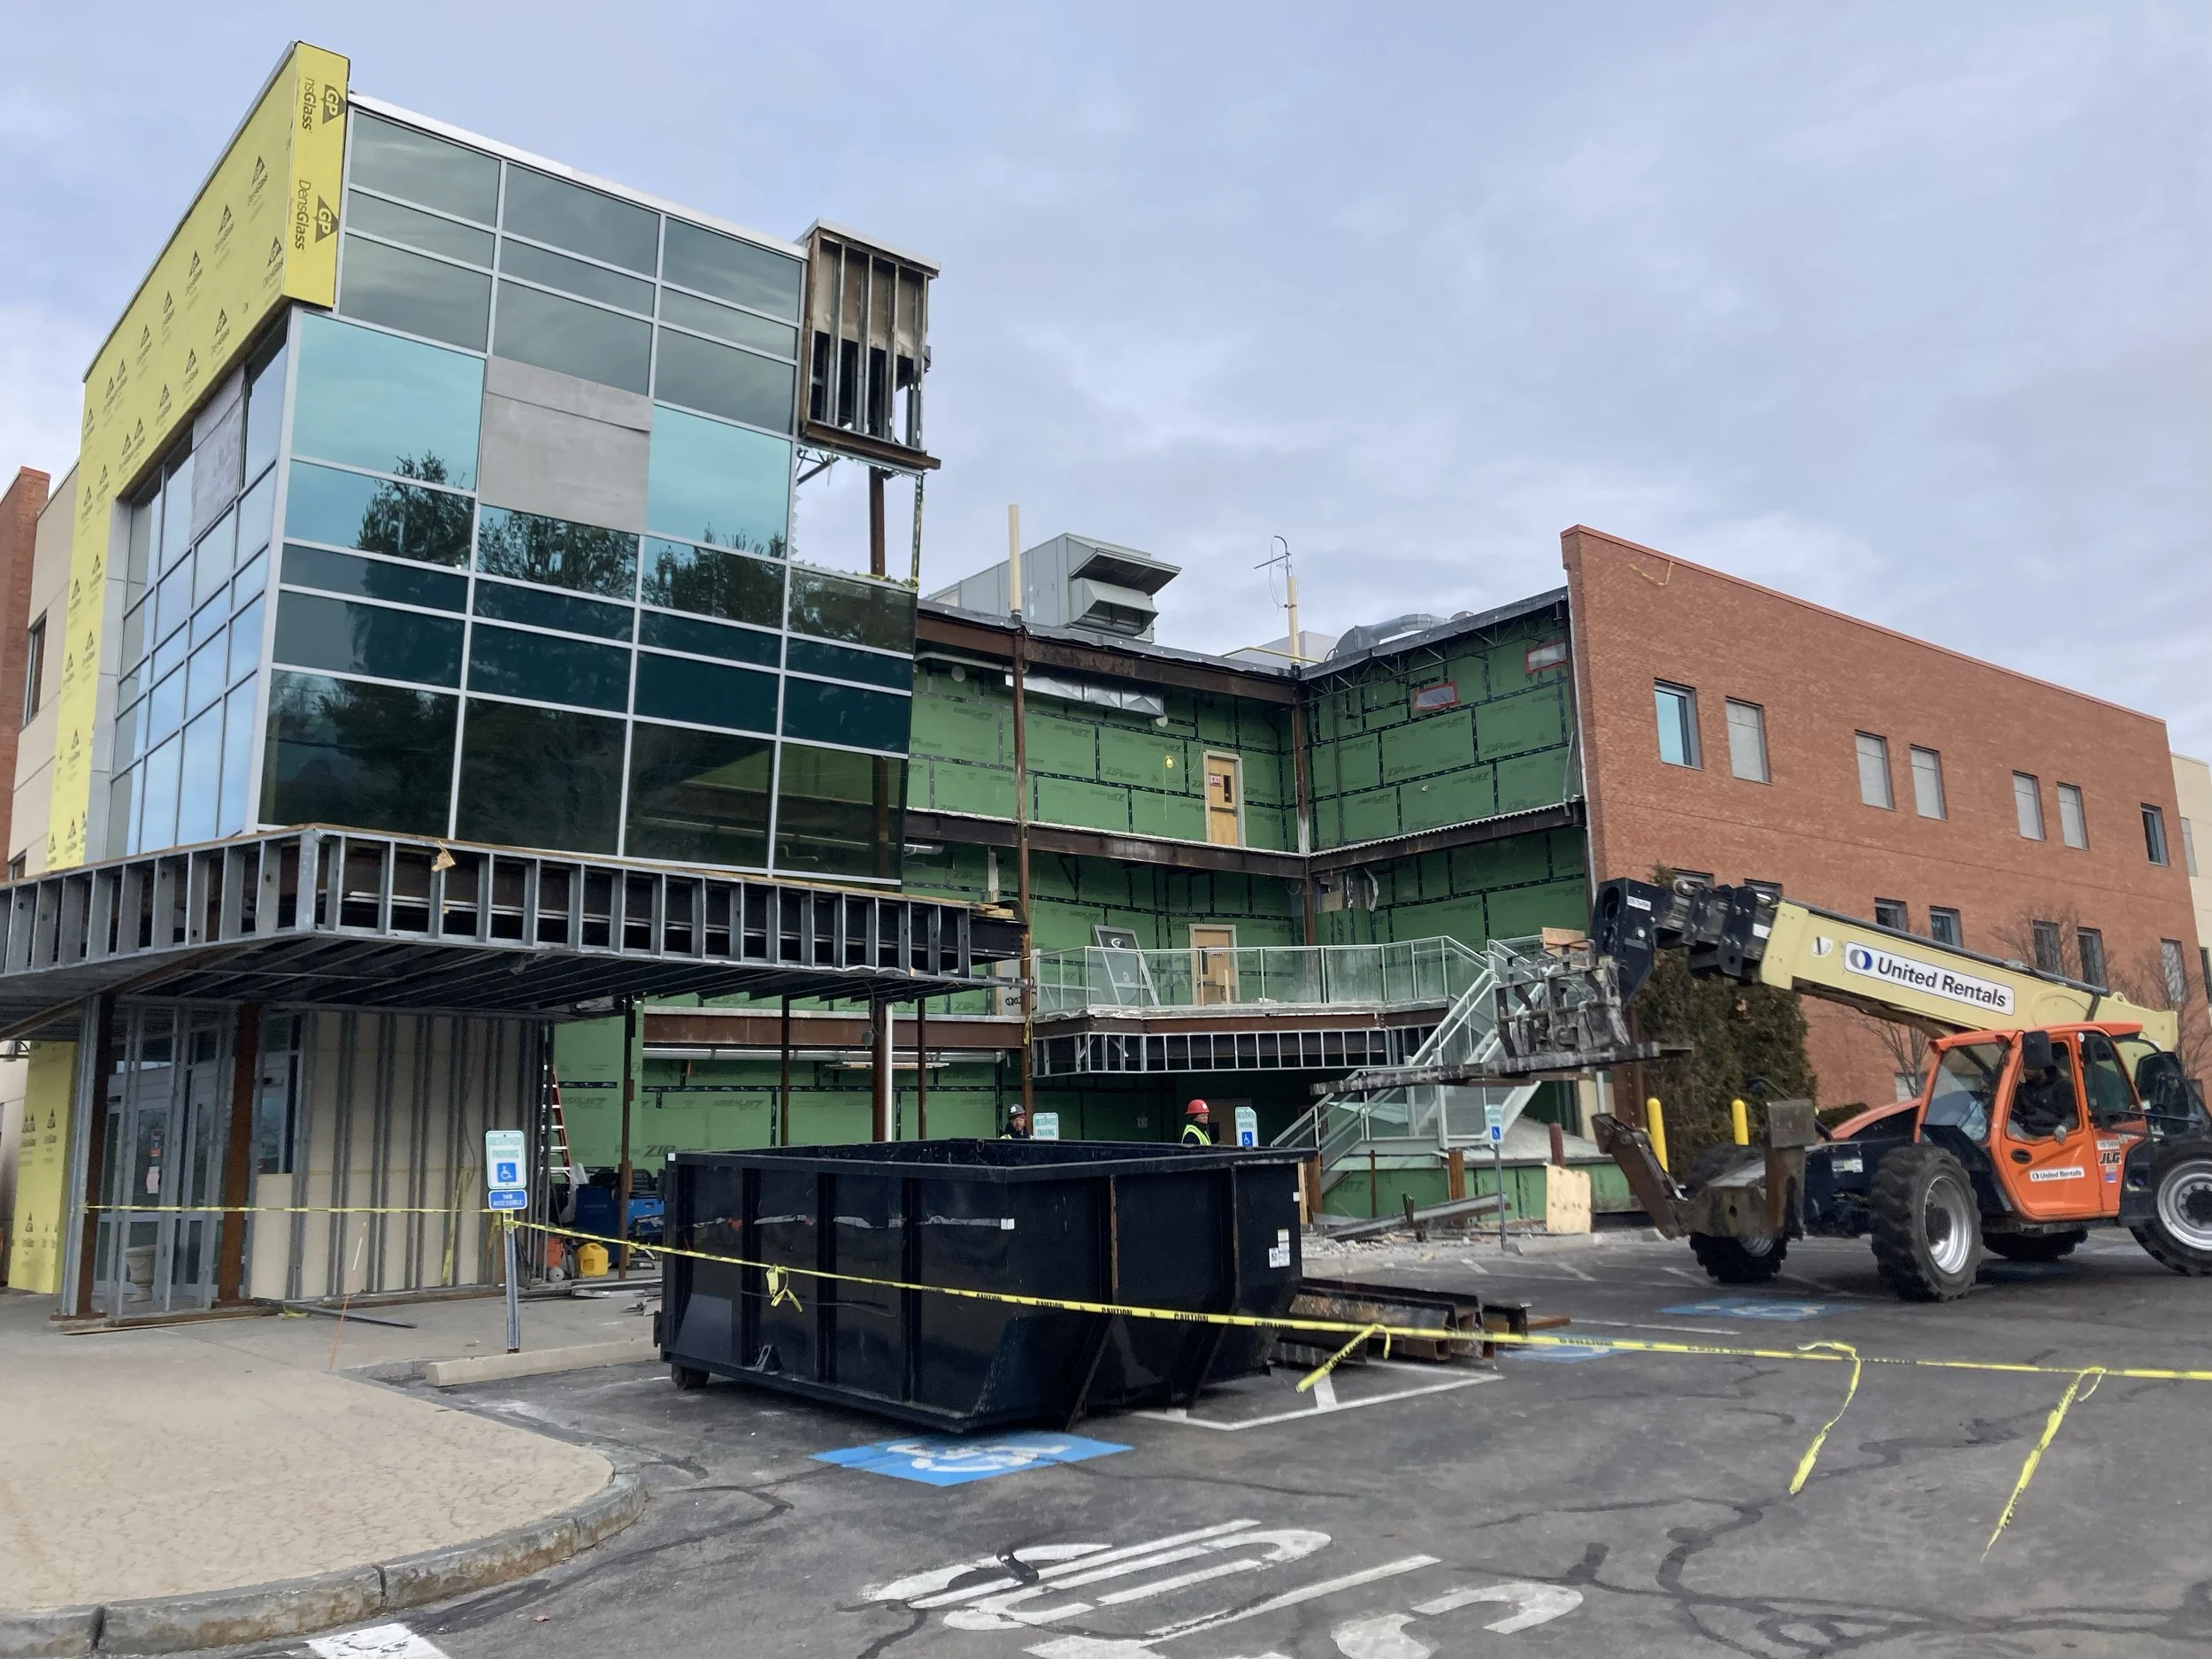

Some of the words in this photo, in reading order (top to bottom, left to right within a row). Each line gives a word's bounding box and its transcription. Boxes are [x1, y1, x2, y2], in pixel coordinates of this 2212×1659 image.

[325, 89, 340, 116] GP
[295, 179, 311, 251] DensGlass
[318, 208, 333, 234] GP
[1210, 775, 1220, 784] EXIT
[1878, 956, 1938, 988] United
[1942, 974, 2006, 1007] Rentals
[2099, 1152, 2121, 1165] JLG
[2059, 1169, 2082, 1178] Rentals
[1036, 1300, 1064, 1310] CAUTION
[1101, 1306, 1133, 1317] CAUTION
[1173, 1312, 1210, 1323] CAUTION
